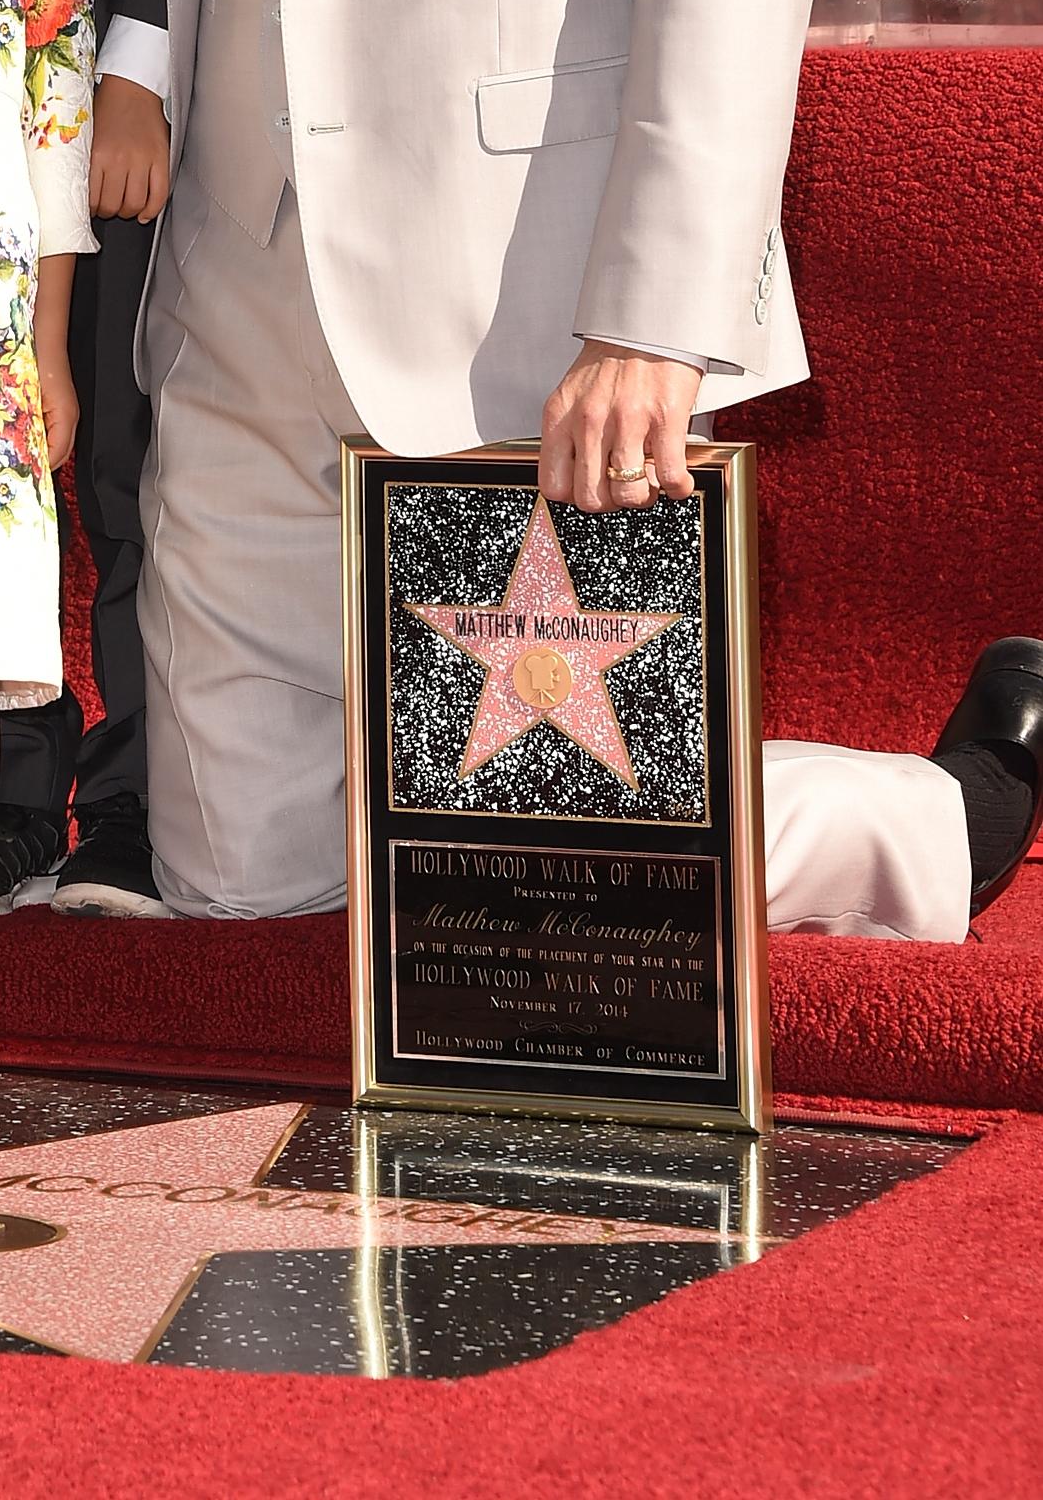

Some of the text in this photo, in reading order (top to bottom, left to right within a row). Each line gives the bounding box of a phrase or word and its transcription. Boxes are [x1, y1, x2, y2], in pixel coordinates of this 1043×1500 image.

[455, 613, 639, 643] MATTHEW McCONAUGHEY
[411, 850, 699, 891] HOLLYWOOD WALK OF FAME
[412, 903, 702, 952] Matthew McConaughey
[413, 941, 704, 971] ON THE OCCASION OF THE PLACEMENT OF YOUR STAR IN THE
[415, 963, 704, 1002] HOLLYWOOD WALK OF FAME
[597, 1003, 629, 1018] 2014
